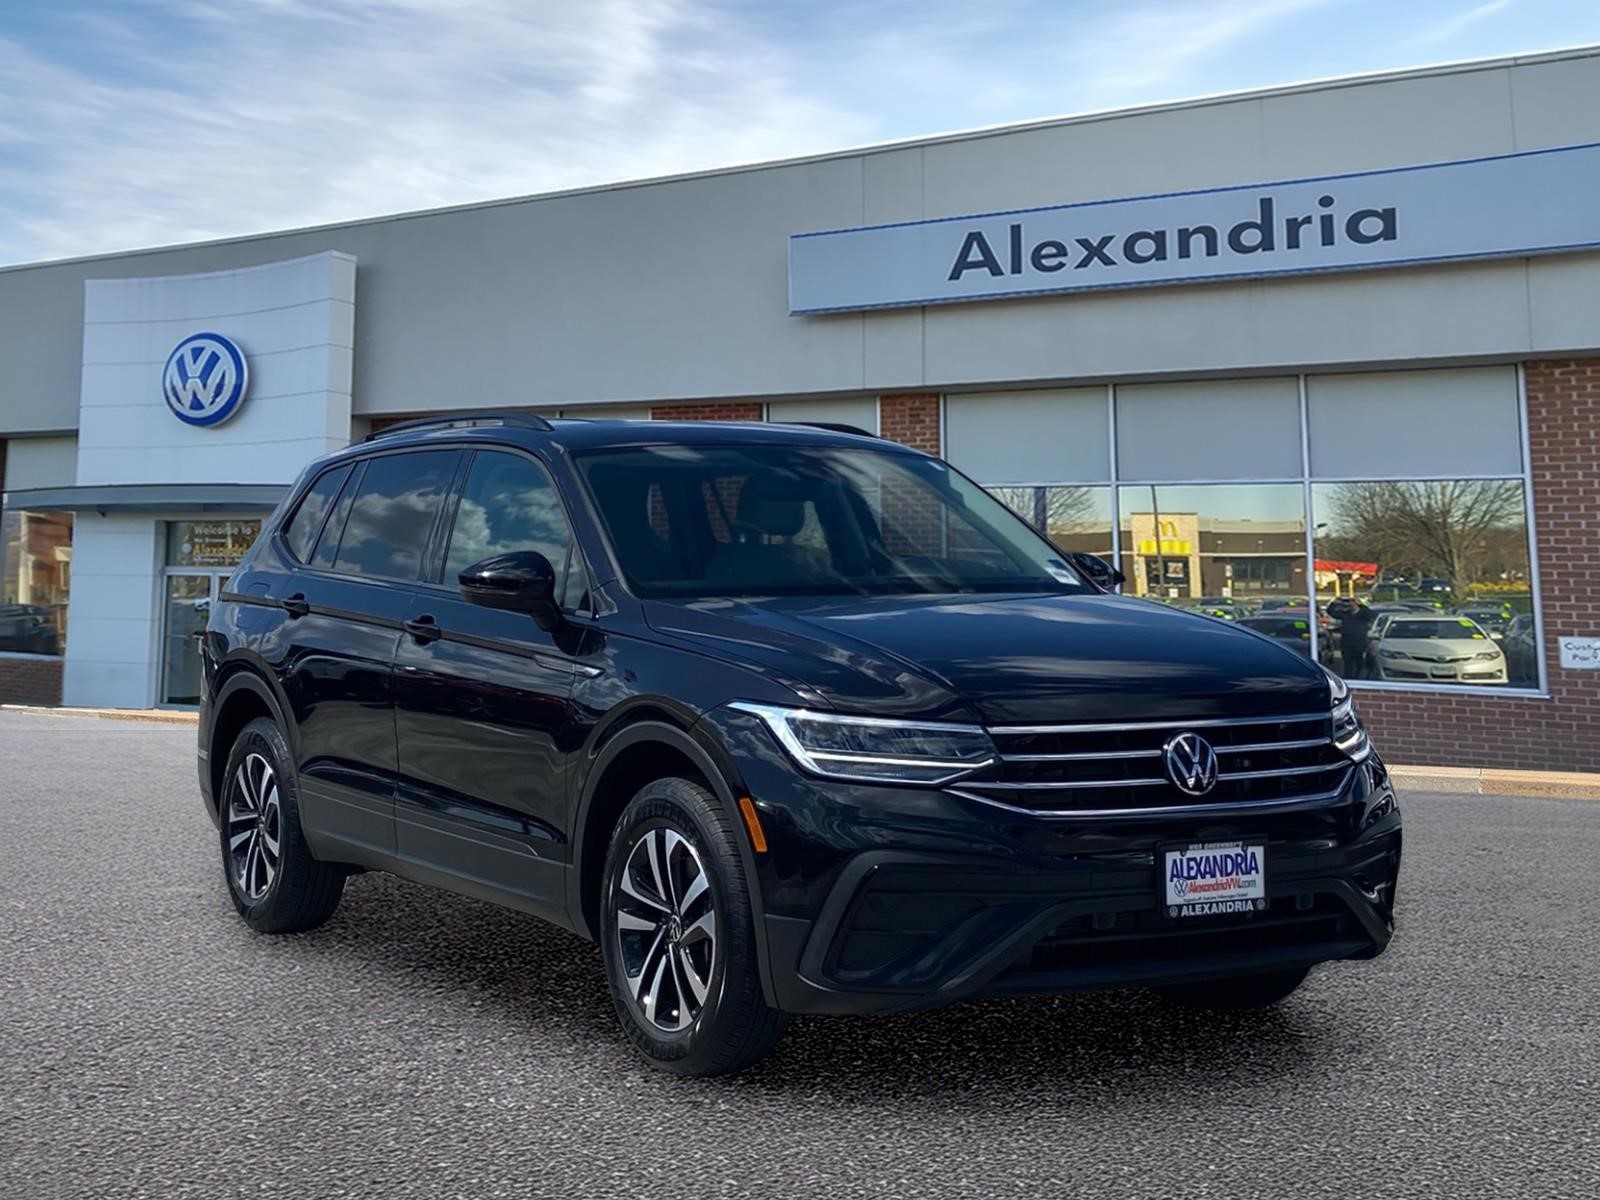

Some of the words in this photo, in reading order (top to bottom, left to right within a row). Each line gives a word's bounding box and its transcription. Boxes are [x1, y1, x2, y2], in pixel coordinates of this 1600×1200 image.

[947, 194, 1398, 282] Alexandria
[1169, 852, 1259, 882] ALEXANDRIA
[1181, 900, 1254, 917] ALEXANDRIA
